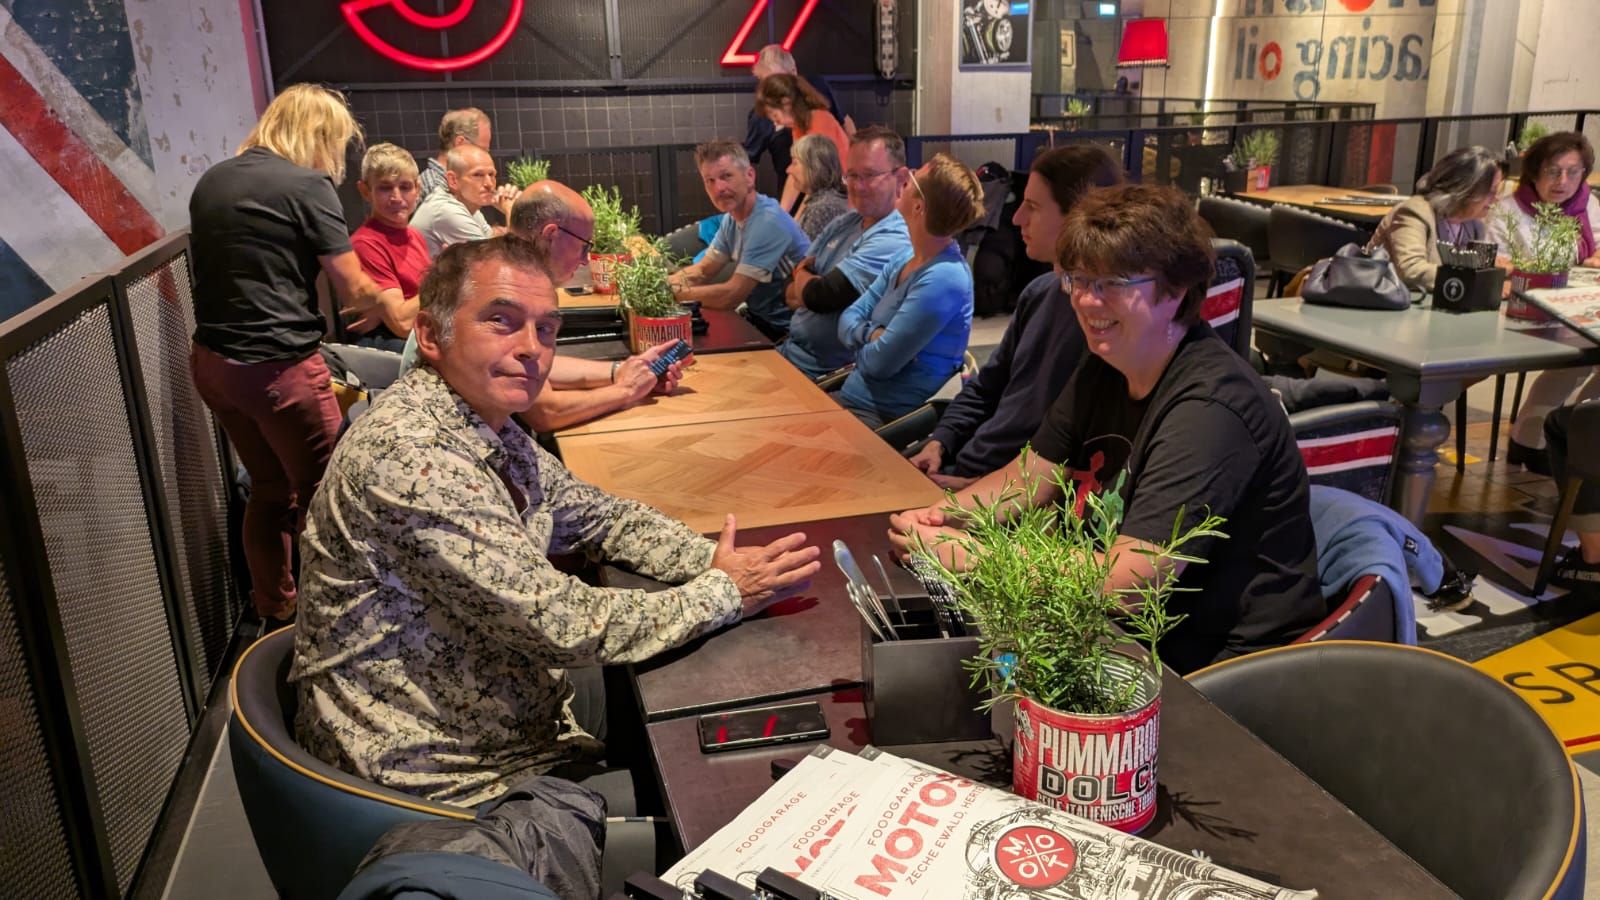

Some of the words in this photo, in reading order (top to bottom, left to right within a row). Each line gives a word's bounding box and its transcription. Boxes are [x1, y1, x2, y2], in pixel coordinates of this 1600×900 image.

[735, 791, 808, 854] FOODGARAGE
[793, 790, 860, 850] FOODGARAGE
[867, 772, 930, 847] FOODGARAGE
[905, 849, 939, 886] ZECHE
[935, 811, 968, 849] EWALD,
